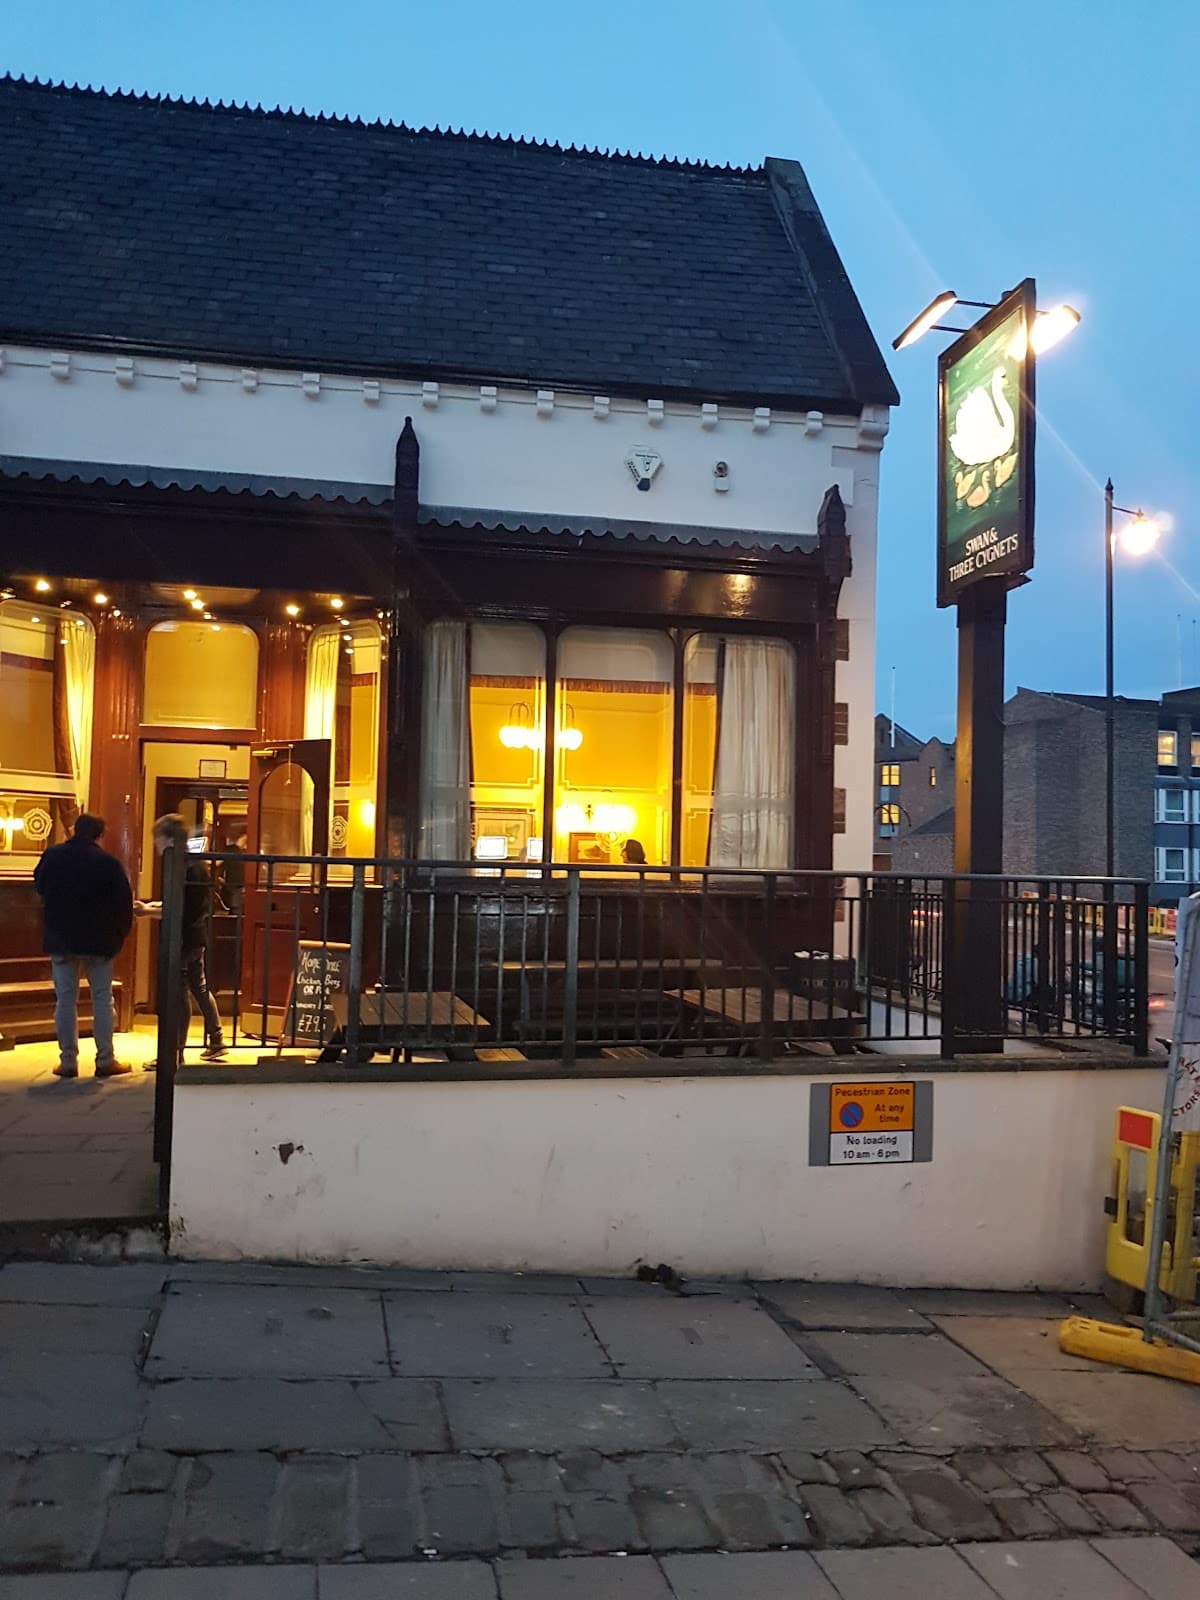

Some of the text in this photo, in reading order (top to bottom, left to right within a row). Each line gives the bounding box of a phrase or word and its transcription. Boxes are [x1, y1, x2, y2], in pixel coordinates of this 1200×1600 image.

[949, 534, 1018, 582] THREE CYGNETS
[835, 1086, 911, 1096] Pedestrian Zone
[875, 1104, 905, 1113] At any
[879, 1114, 900, 1123] time
[847, 1136, 897, 1145] No loading
